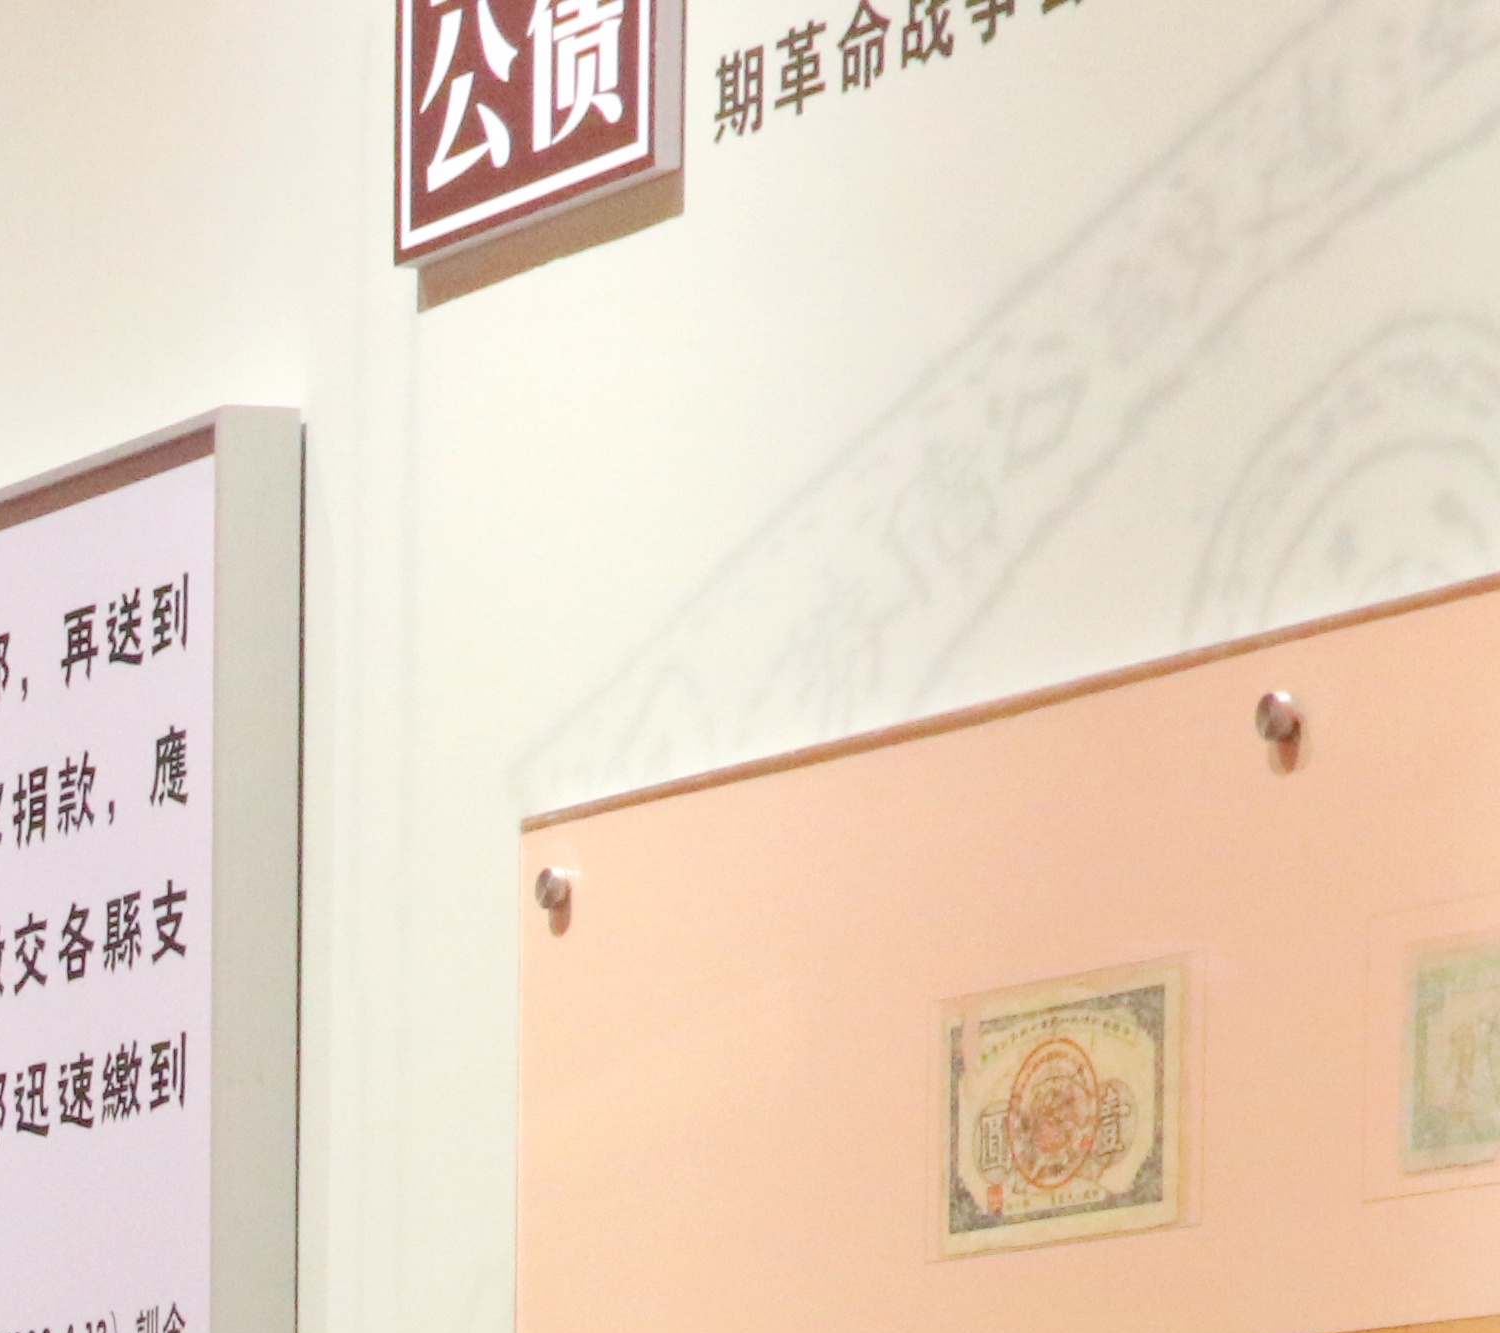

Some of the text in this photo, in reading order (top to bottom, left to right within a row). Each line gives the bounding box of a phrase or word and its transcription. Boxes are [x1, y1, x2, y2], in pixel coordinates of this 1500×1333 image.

[420, 0, 622, 193] 公债
[713, 0, 1083, 143] 期革命战
